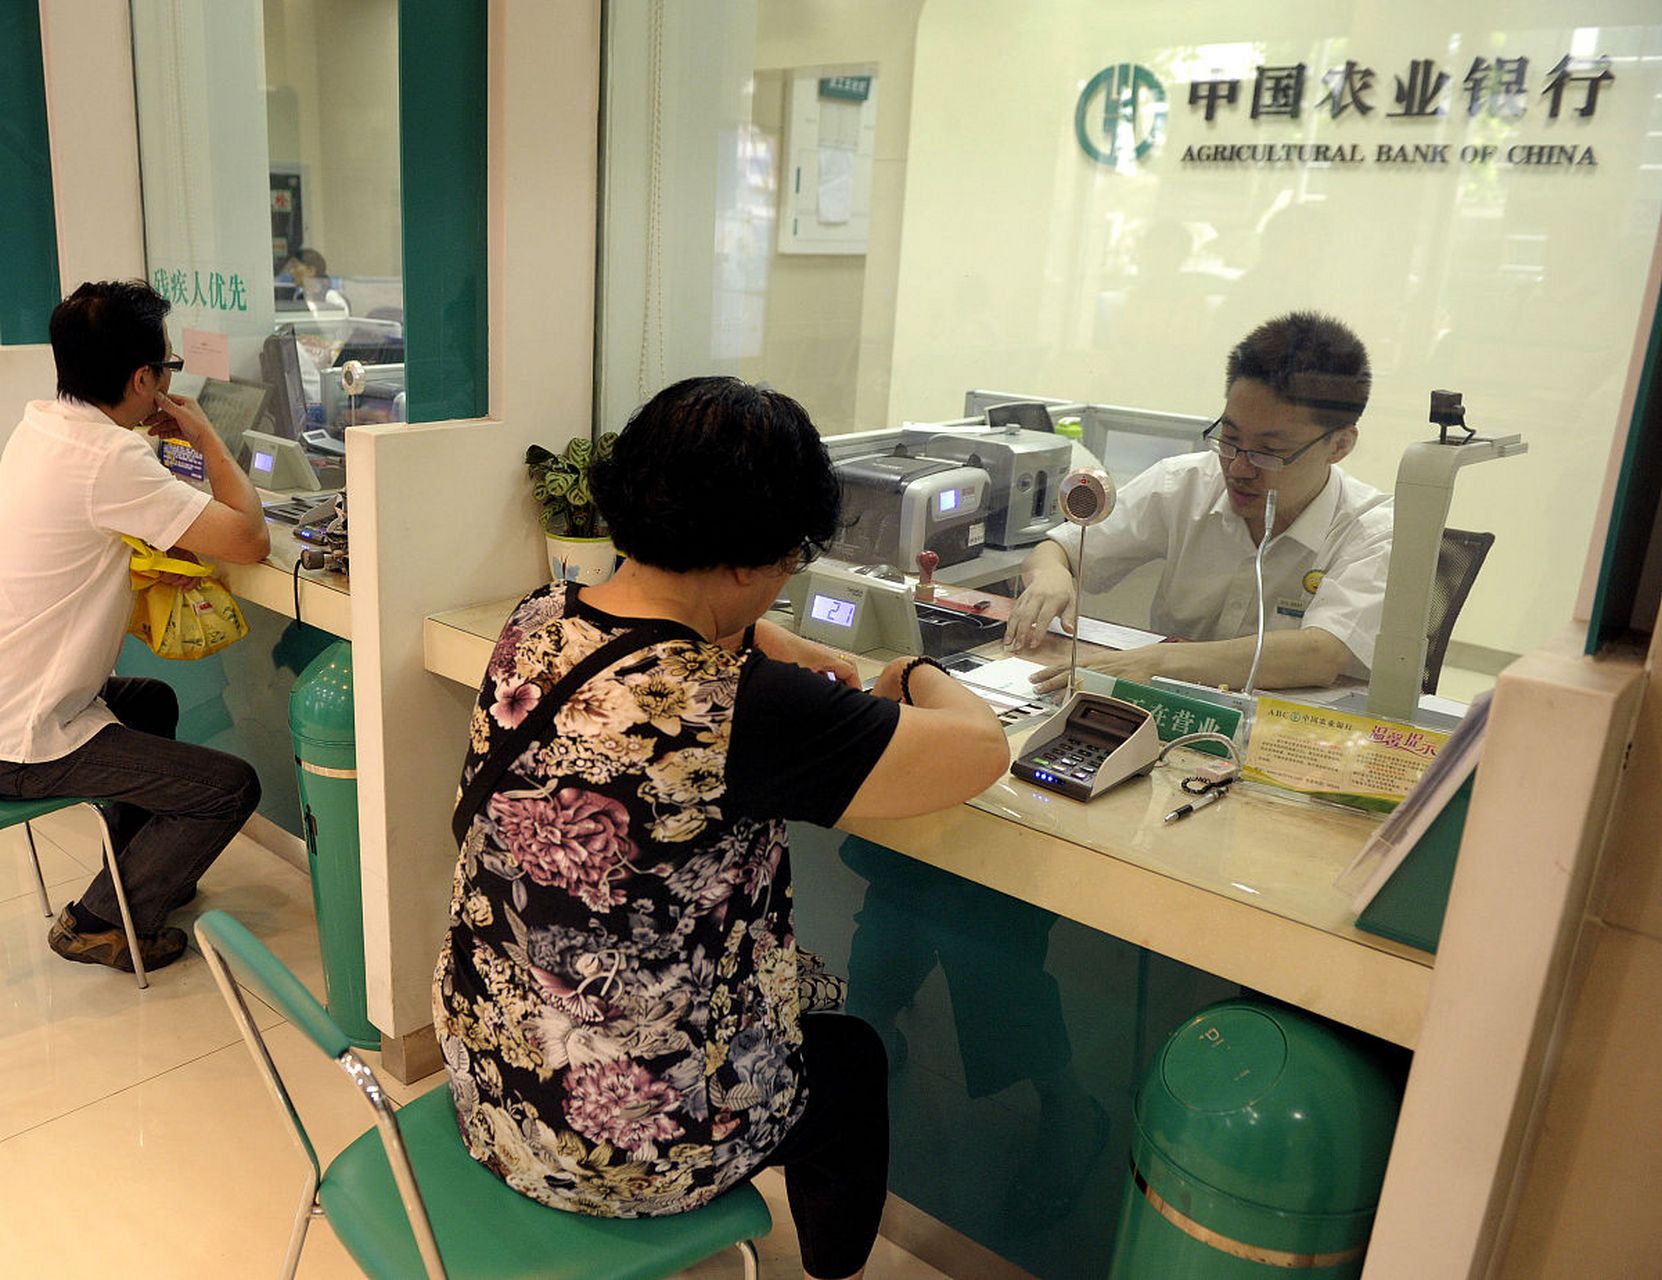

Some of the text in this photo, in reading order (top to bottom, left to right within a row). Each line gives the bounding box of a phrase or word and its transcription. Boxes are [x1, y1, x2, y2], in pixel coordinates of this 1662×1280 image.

[1187, 54, 1616, 122] 中国农业银行
[1181, 143, 1597, 167] AGRICULTURAL BANK OF CHINA
[827, 600, 854, 624] 21
[1267, 708, 1290, 720] ABC
